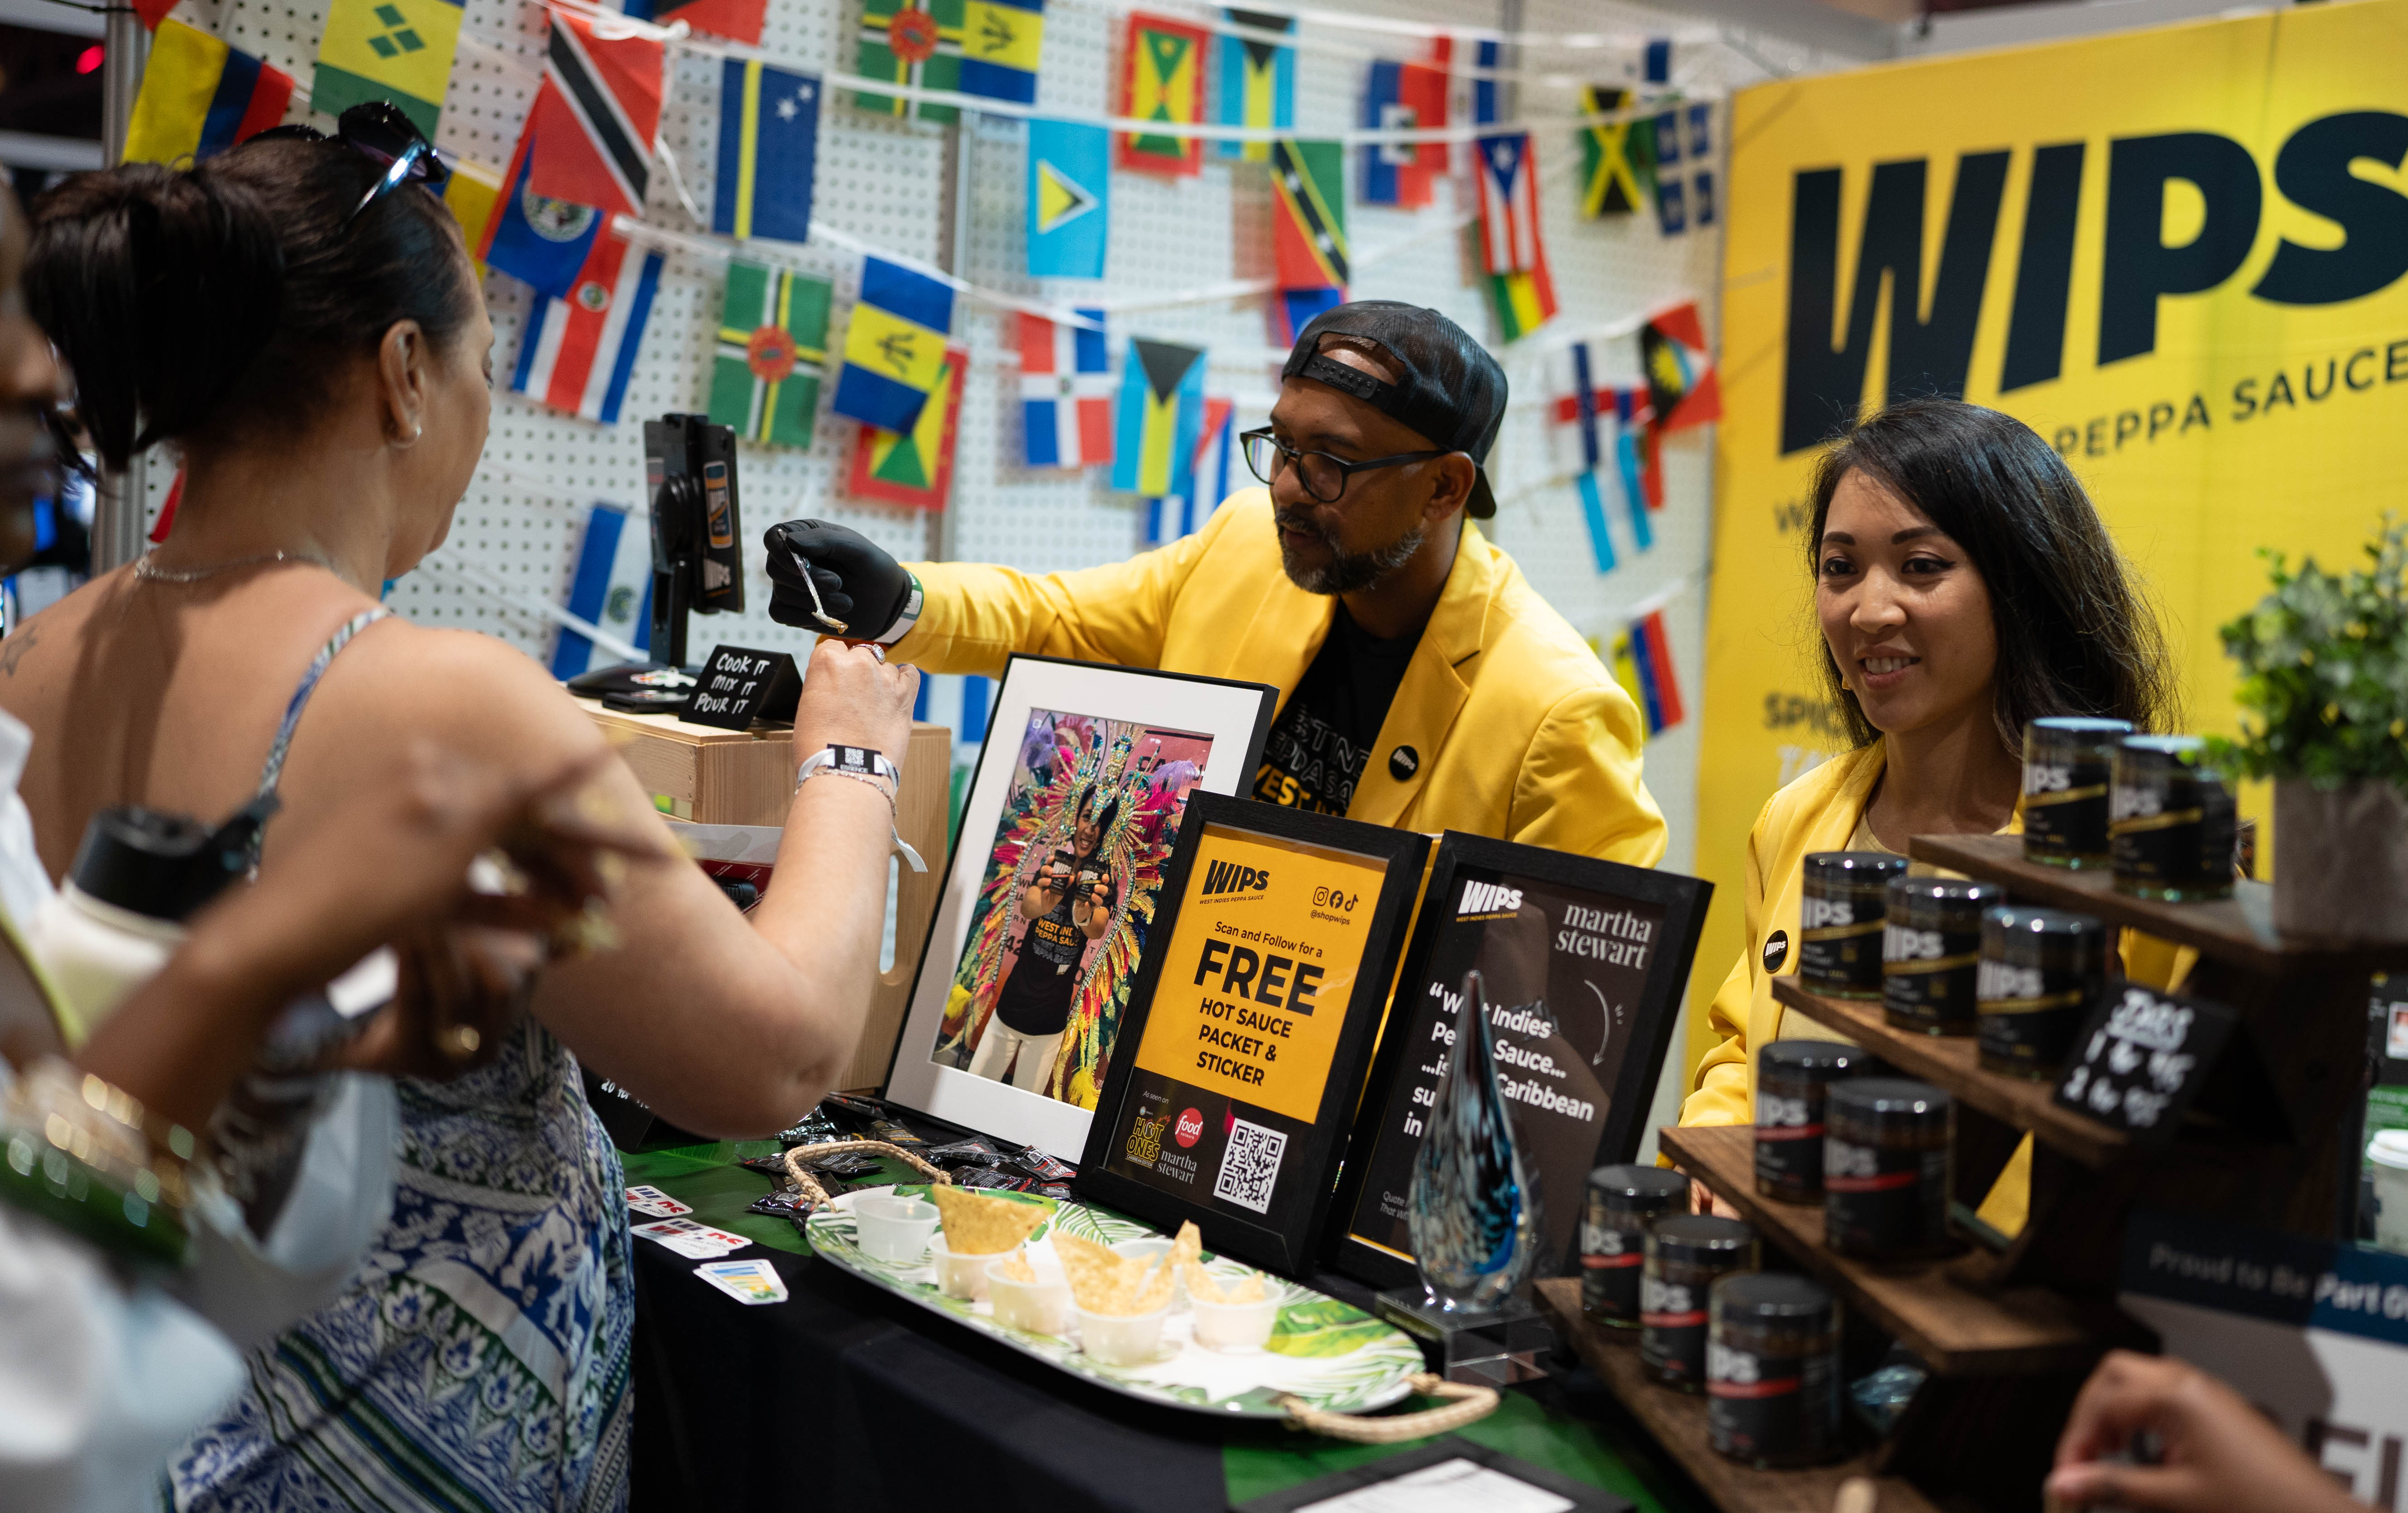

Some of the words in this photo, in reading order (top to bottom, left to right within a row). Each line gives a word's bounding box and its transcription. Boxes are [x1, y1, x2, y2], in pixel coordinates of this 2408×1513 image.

[1779, 110, 2408, 461] WIPS
[2054, 392, 2211, 456] PEPPA
[2230, 338, 2408, 422] SAUCE
[716, 653, 752, 674] COOK
[753, 660, 770, 676] IT
[710, 674, 738, 692] MIX
[741, 681, 757, 696] IT
[694, 692, 729, 713] POUR
[732, 699, 749, 714] IT
[1053, 861, 1072, 874] WIPS
[1202, 859, 1270, 895] WIPS
[1458, 880, 1523, 914] WIPS
[1311, 910, 1350, 926] @shopwips
[1562, 904, 1652, 943] martha
[1801, 896, 1854, 928] IPS
[1035, 926, 1058, 943] PEPPA
[1038, 917, 1060, 934] WEST
[1215, 921, 1239, 936] Scan
[1241, 928, 1261, 942] and
[1262, 933, 1297, 951] Follow
[1299, 942, 1314, 954] for
[1316, 949, 1322, 958] a
[1555, 929, 1648, 970] stewart
[1765, 941, 1786, 957] WIPS
[1193, 938, 1325, 1017] FREE
[1200, 997, 1235, 1021] HOT
[1236, 1008, 1293, 1039] SAUCE
[1491, 1005, 1552, 1040] Indies
[1198, 1024, 1263, 1057] PACKET
[1265, 1044, 1277, 1062] &
[1196, 1051, 1264, 1087] STICKER
[1493, 1039, 1567, 1080] Sauce...
[1149, 1093, 1162, 1102] seen
[1498, 1073, 1595, 1122] Caribbean
[1133, 1117, 1165, 1143] HOT
[1175, 1115, 1203, 1136] food
[1180, 1132, 1194, 1140] network
[1126, 1135, 1161, 1162] ONES
[1126, 1154, 1142, 1164] CARIBBEAN
[1160, 1150, 1197, 1172] martha
[1157, 1162, 1196, 1185] stewart
[1380, 1202, 1397, 1217] That
[1383, 1191, 1405, 1207] Quote
[2314, 1271, 2381, 1315] Part
